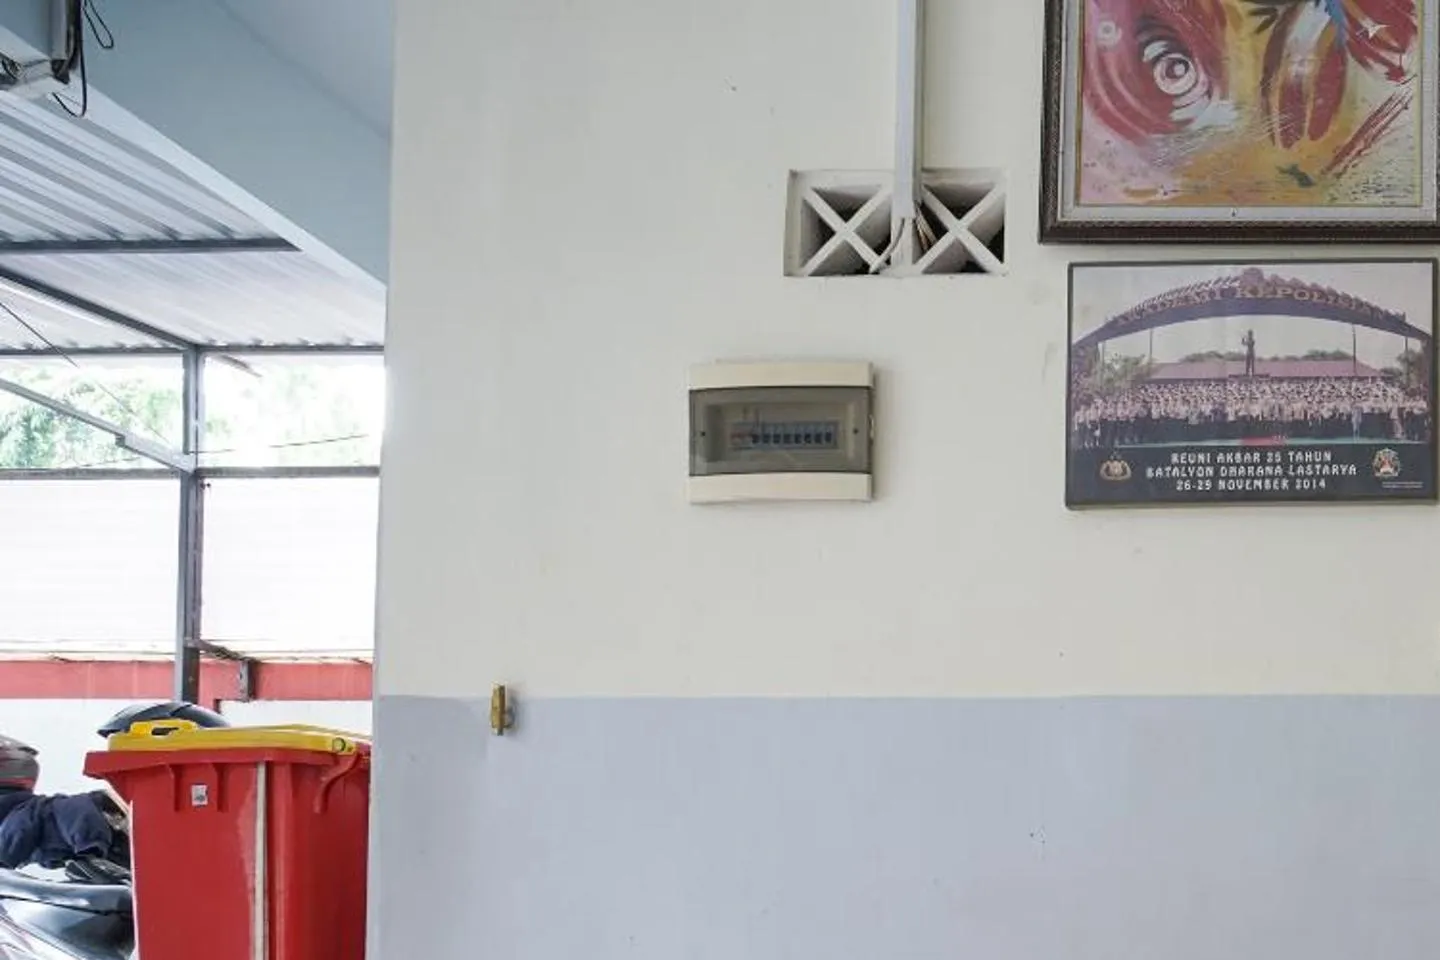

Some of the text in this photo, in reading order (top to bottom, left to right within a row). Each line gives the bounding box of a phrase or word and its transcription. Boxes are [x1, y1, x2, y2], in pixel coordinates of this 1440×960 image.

[1171, 451, 1332, 465] REUNI AKBAR 25 TAHUN
[1146, 463, 1358, 478] BATALYON DHARANA LASTARYA
[1218, 478, 1289, 490] NOVEMBER
[1295, 478, 1326, 490] 2014
